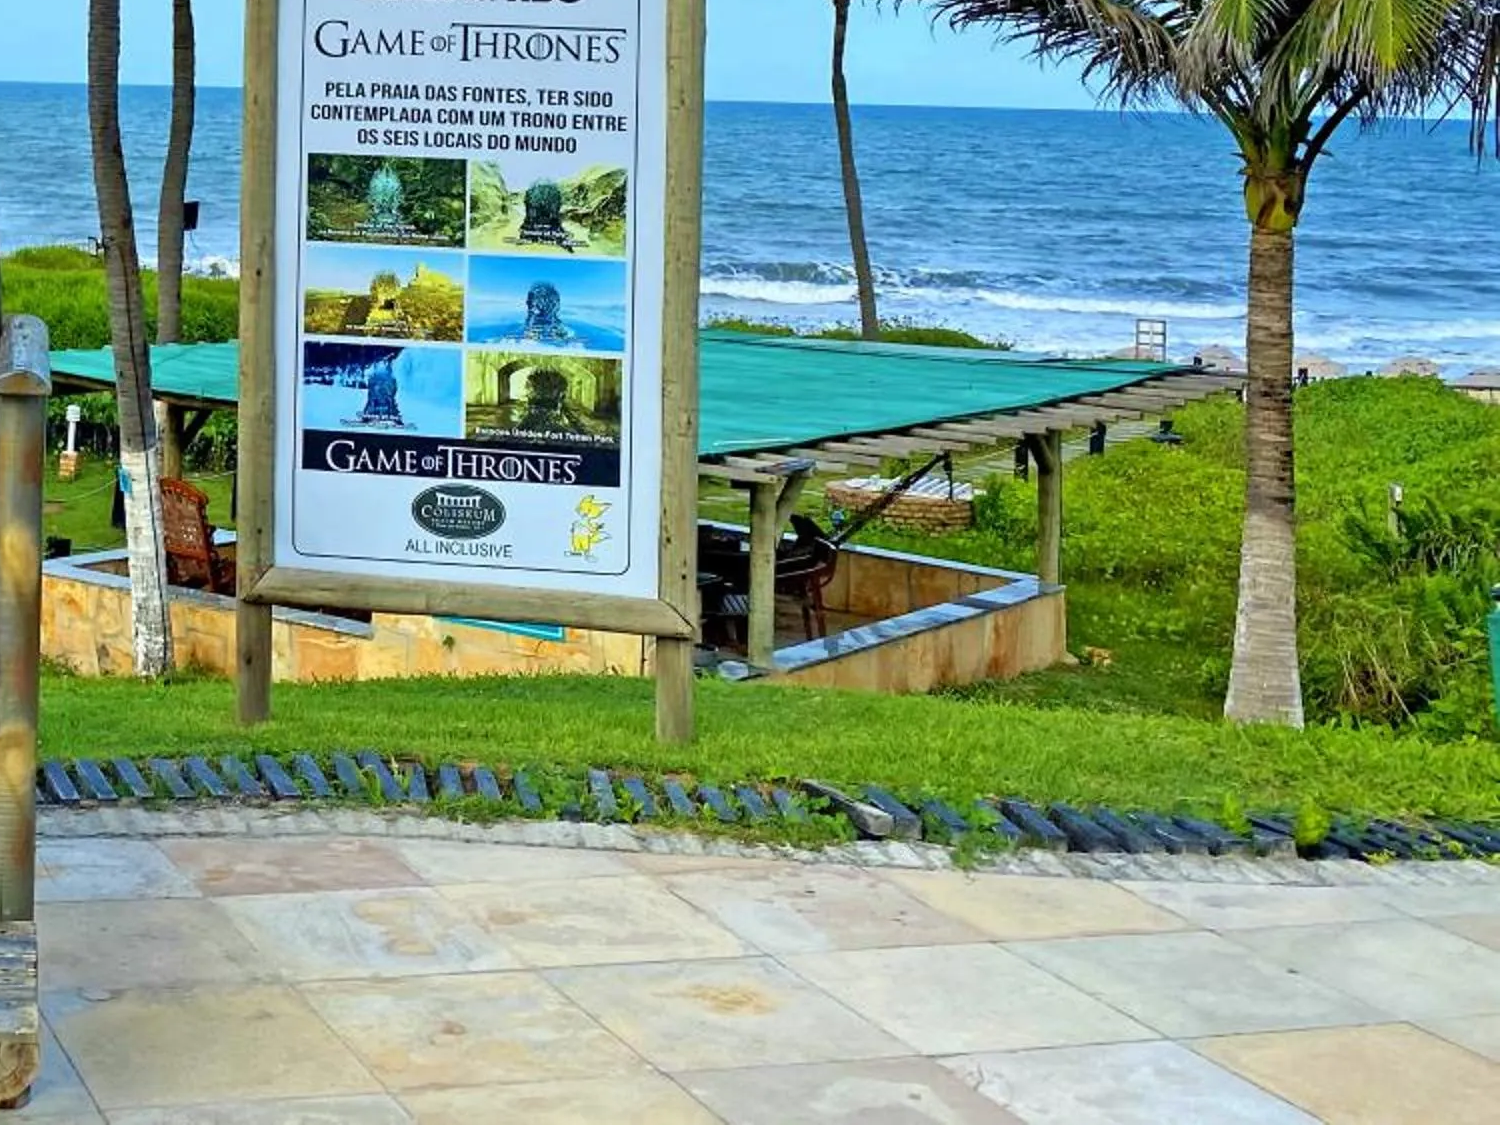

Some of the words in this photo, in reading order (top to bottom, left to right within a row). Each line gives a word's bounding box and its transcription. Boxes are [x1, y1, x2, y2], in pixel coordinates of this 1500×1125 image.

[325, 82, 366, 98] PELA
[371, 83, 420, 100] PRAIA
[425, 85, 457, 102] DAS
[462, 86, 532, 106] FONTES,
[538, 89, 569, 106] TER
[573, 90, 613, 108] SIDO
[311, 104, 432, 124] CONTEMPLADA
[437, 109, 474, 125] COM
[479, 110, 505, 126] UM
[511, 111, 567, 130] TRONO
[572, 114, 627, 132] ENTRE
[357, 128, 379, 145] OS
[383, 130, 419, 146] SEIS
[424, 131, 483, 149] LOCAIS
[487, 134, 510, 150] DO
[515, 135, 577, 154] MUNDO
[405, 538, 433, 554] ALL
[435, 541, 513, 559] INCLUSIVE
